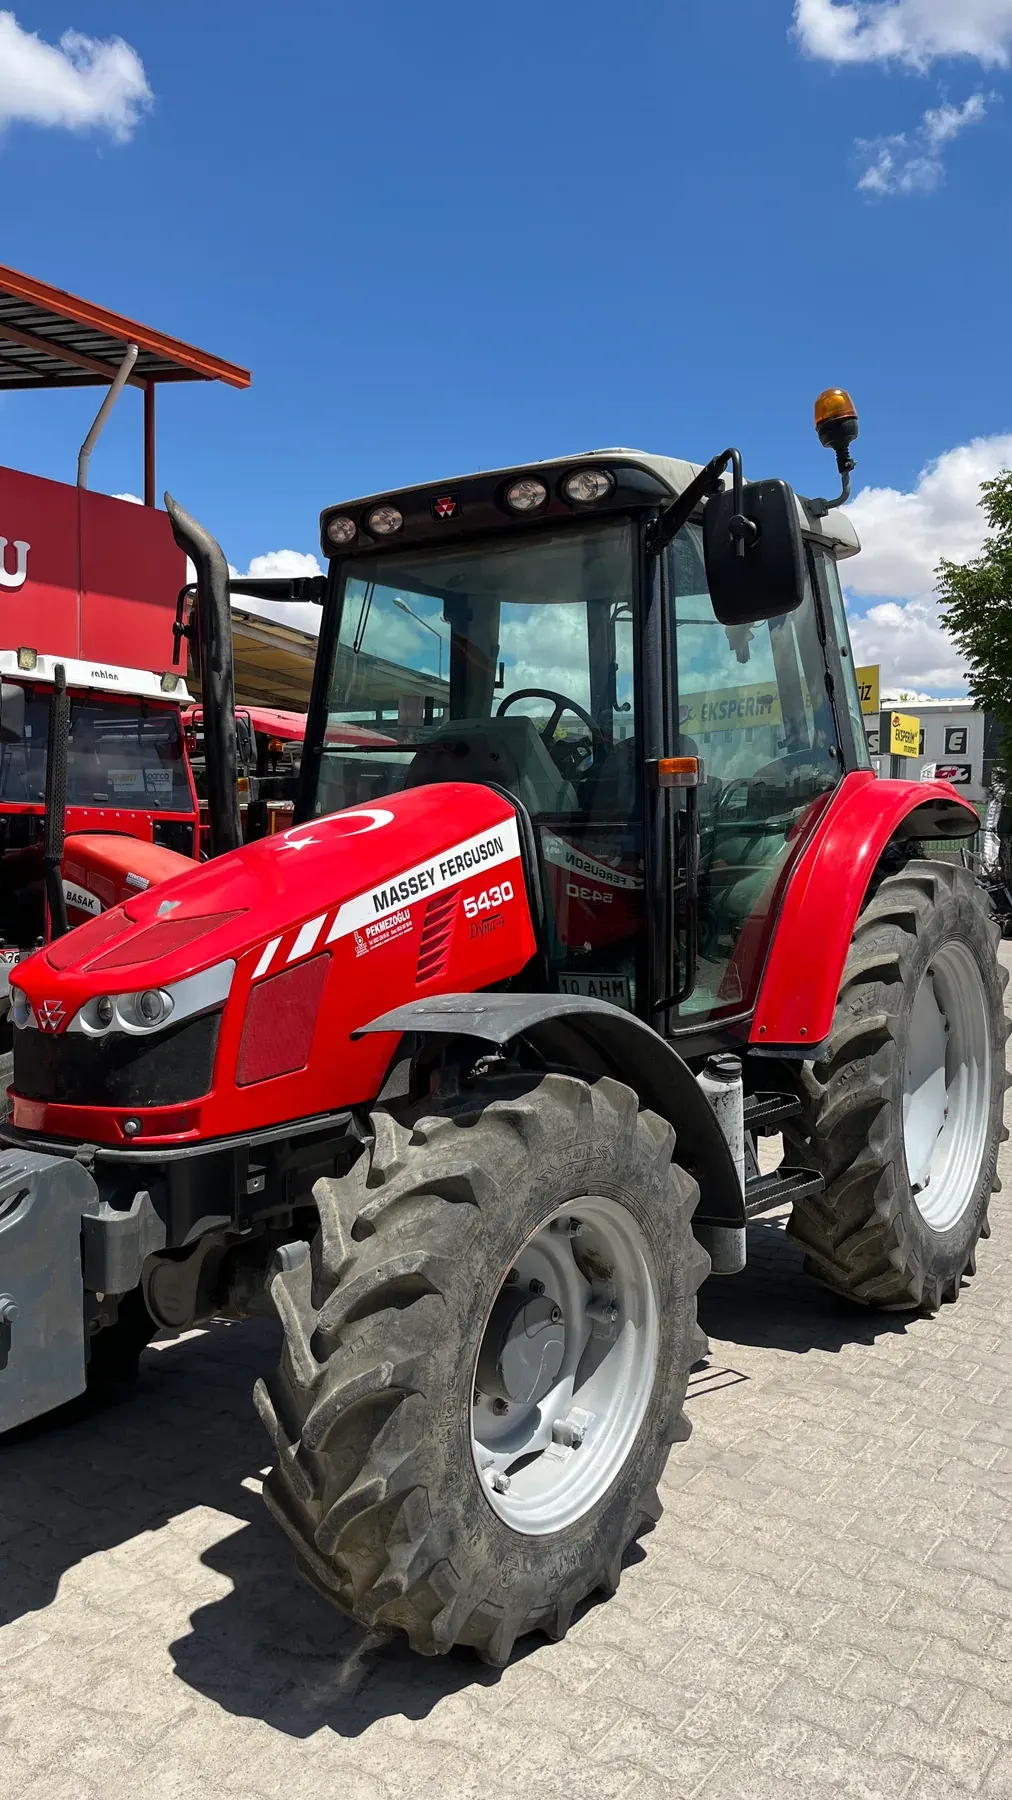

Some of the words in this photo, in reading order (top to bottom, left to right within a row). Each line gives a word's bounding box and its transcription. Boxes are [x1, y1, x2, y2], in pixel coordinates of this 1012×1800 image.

[948, 731, 964, 751] E
[372, 867, 435, 913] MASSEY
[438, 836, 504, 881] FERGUSON
[463, 880, 514, 919] 5430
[365, 908, 411, 939] PEKMEZOĞLU
[587, 980, 624, 998] AHM
